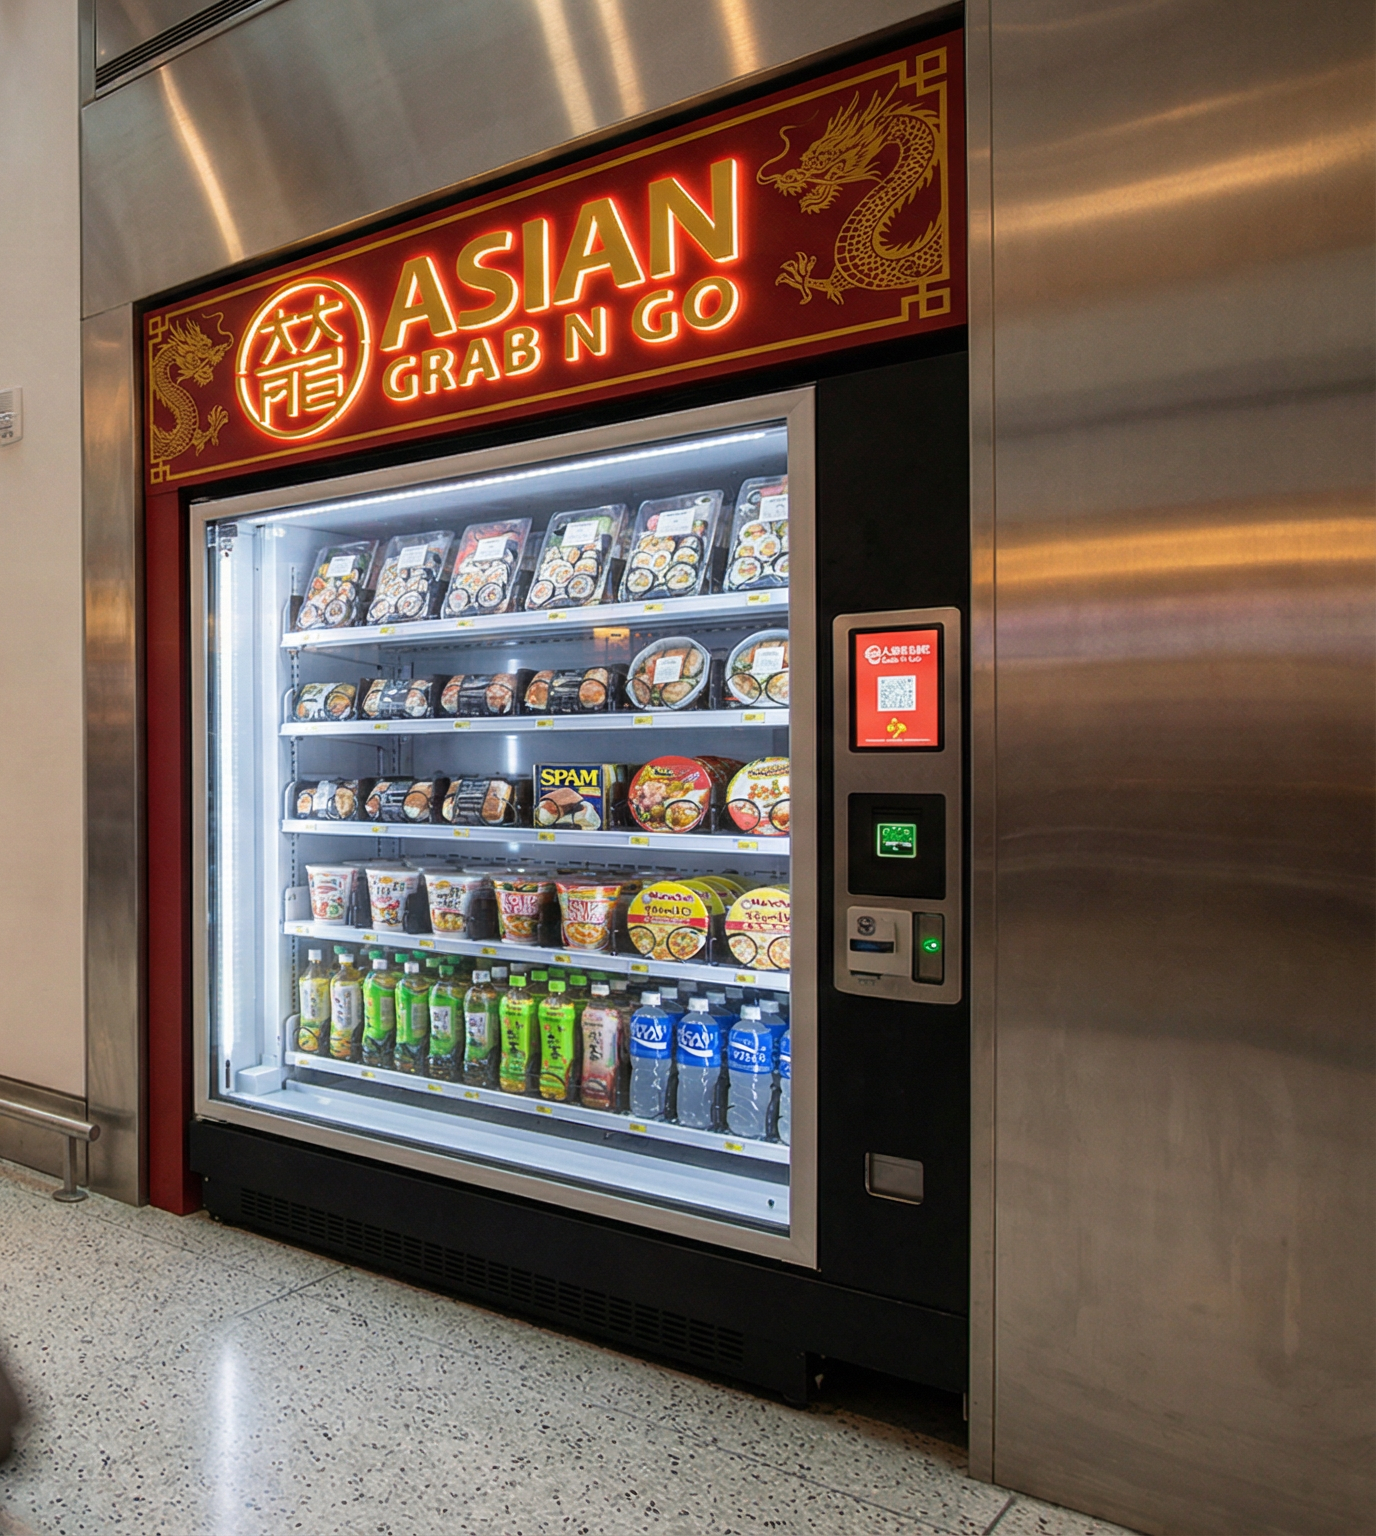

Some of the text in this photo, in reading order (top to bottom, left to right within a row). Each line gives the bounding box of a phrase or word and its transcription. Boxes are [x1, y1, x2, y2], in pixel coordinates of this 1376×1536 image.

[379, 158, 739, 352] ASIAN
[382, 326, 541, 401] GRAB
[564, 306, 607, 362] N
[632, 276, 739, 343] GO
[540, 768, 599, 787] SPAM
